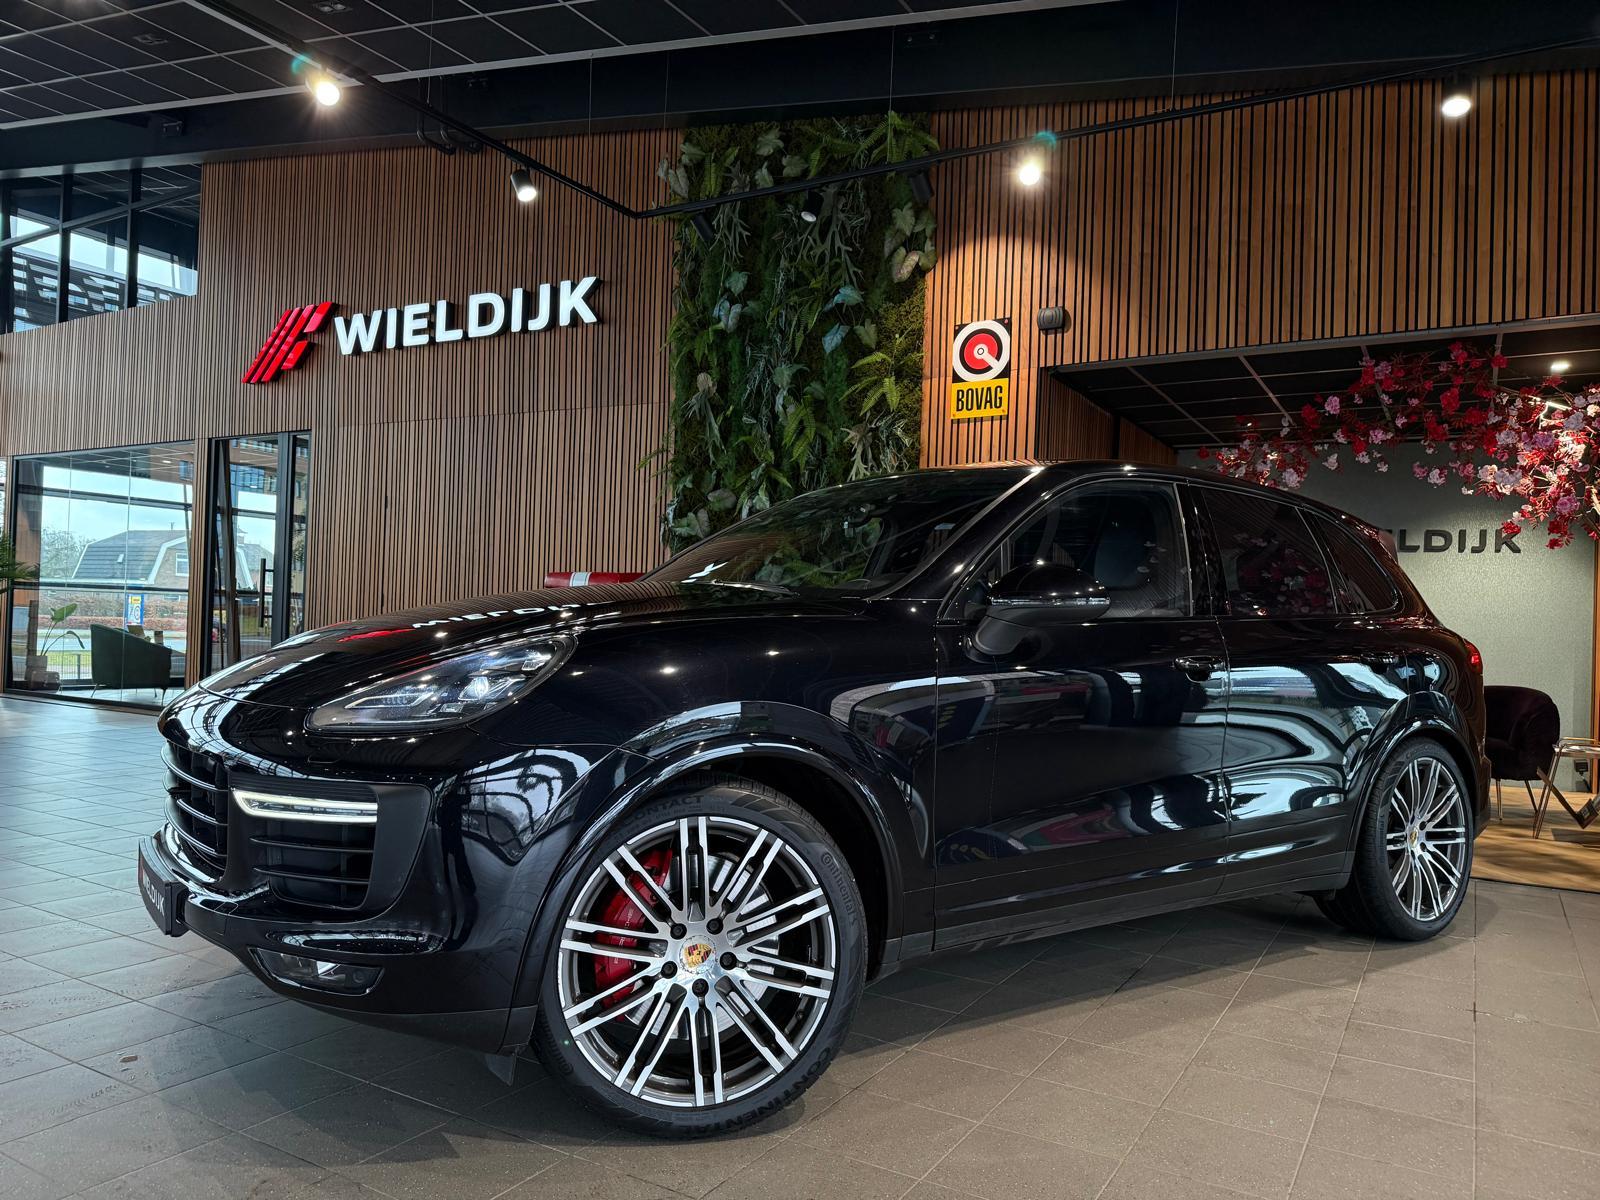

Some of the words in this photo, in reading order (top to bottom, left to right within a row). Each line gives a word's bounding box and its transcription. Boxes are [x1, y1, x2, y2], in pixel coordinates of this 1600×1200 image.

[334, 276, 598, 356] WIELDIJK
[956, 385, 1003, 412] BOVAG
[819, 851, 857, 916] Continental
